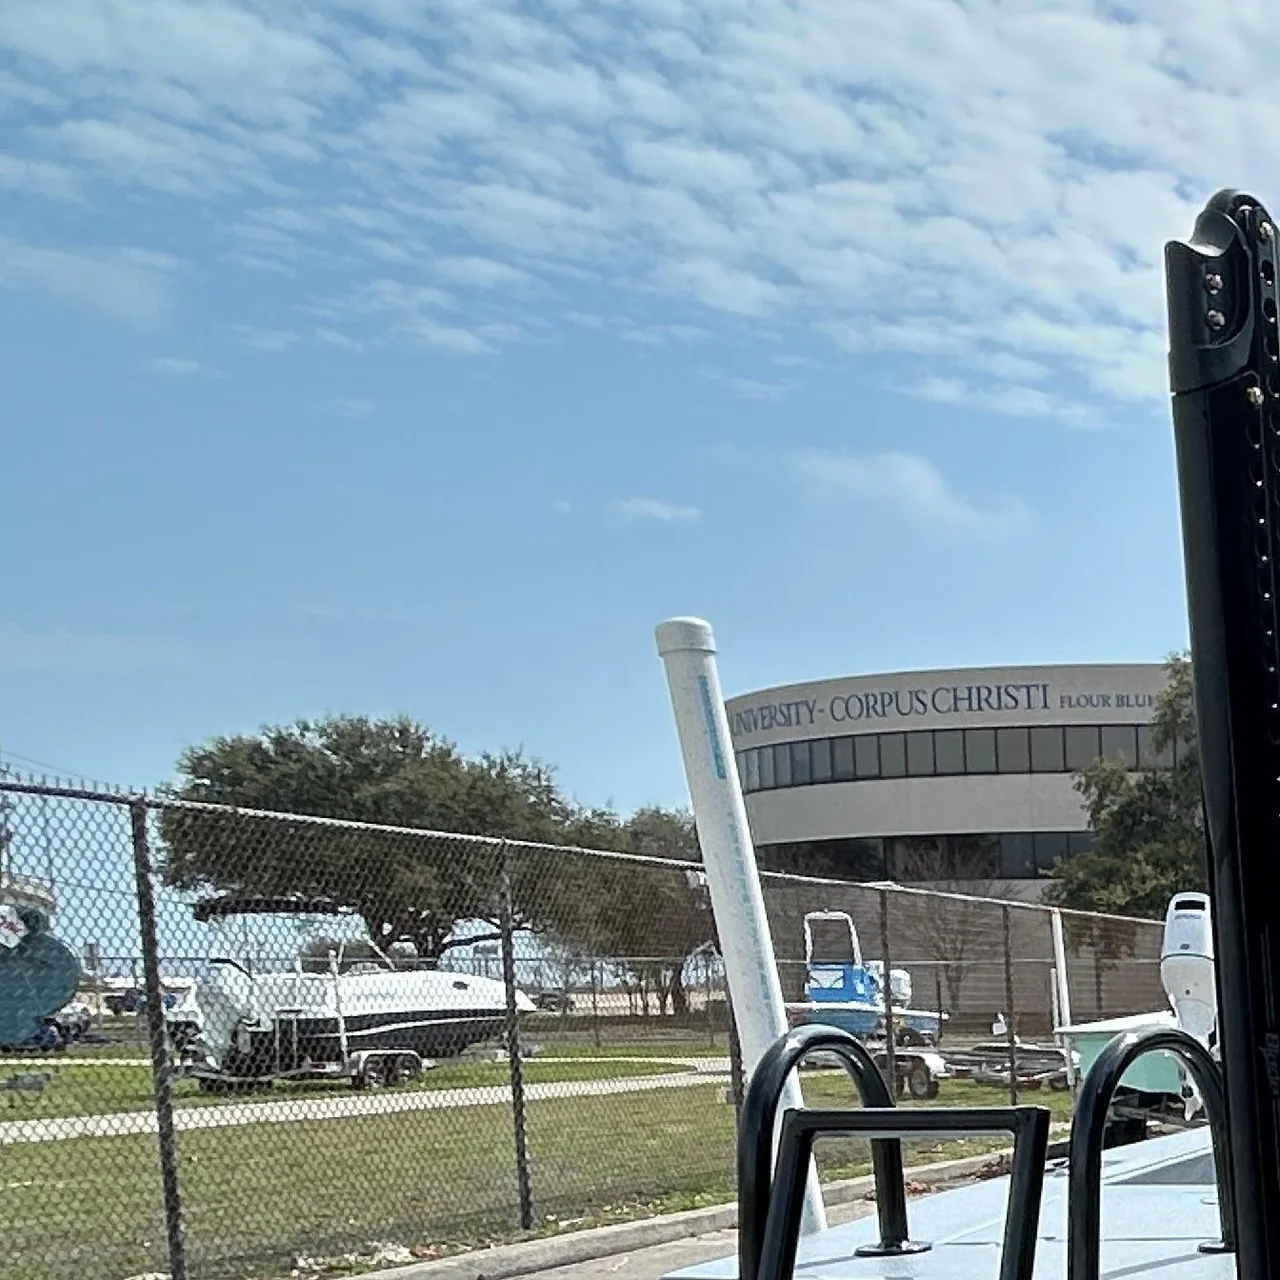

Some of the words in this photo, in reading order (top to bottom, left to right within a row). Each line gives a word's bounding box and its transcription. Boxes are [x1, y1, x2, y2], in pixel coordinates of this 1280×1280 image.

[829, 690, 928, 723] CORPUS
[931, 684, 1051, 715] CHRISTI
[1059, 693, 1112, 709] FLOUR
